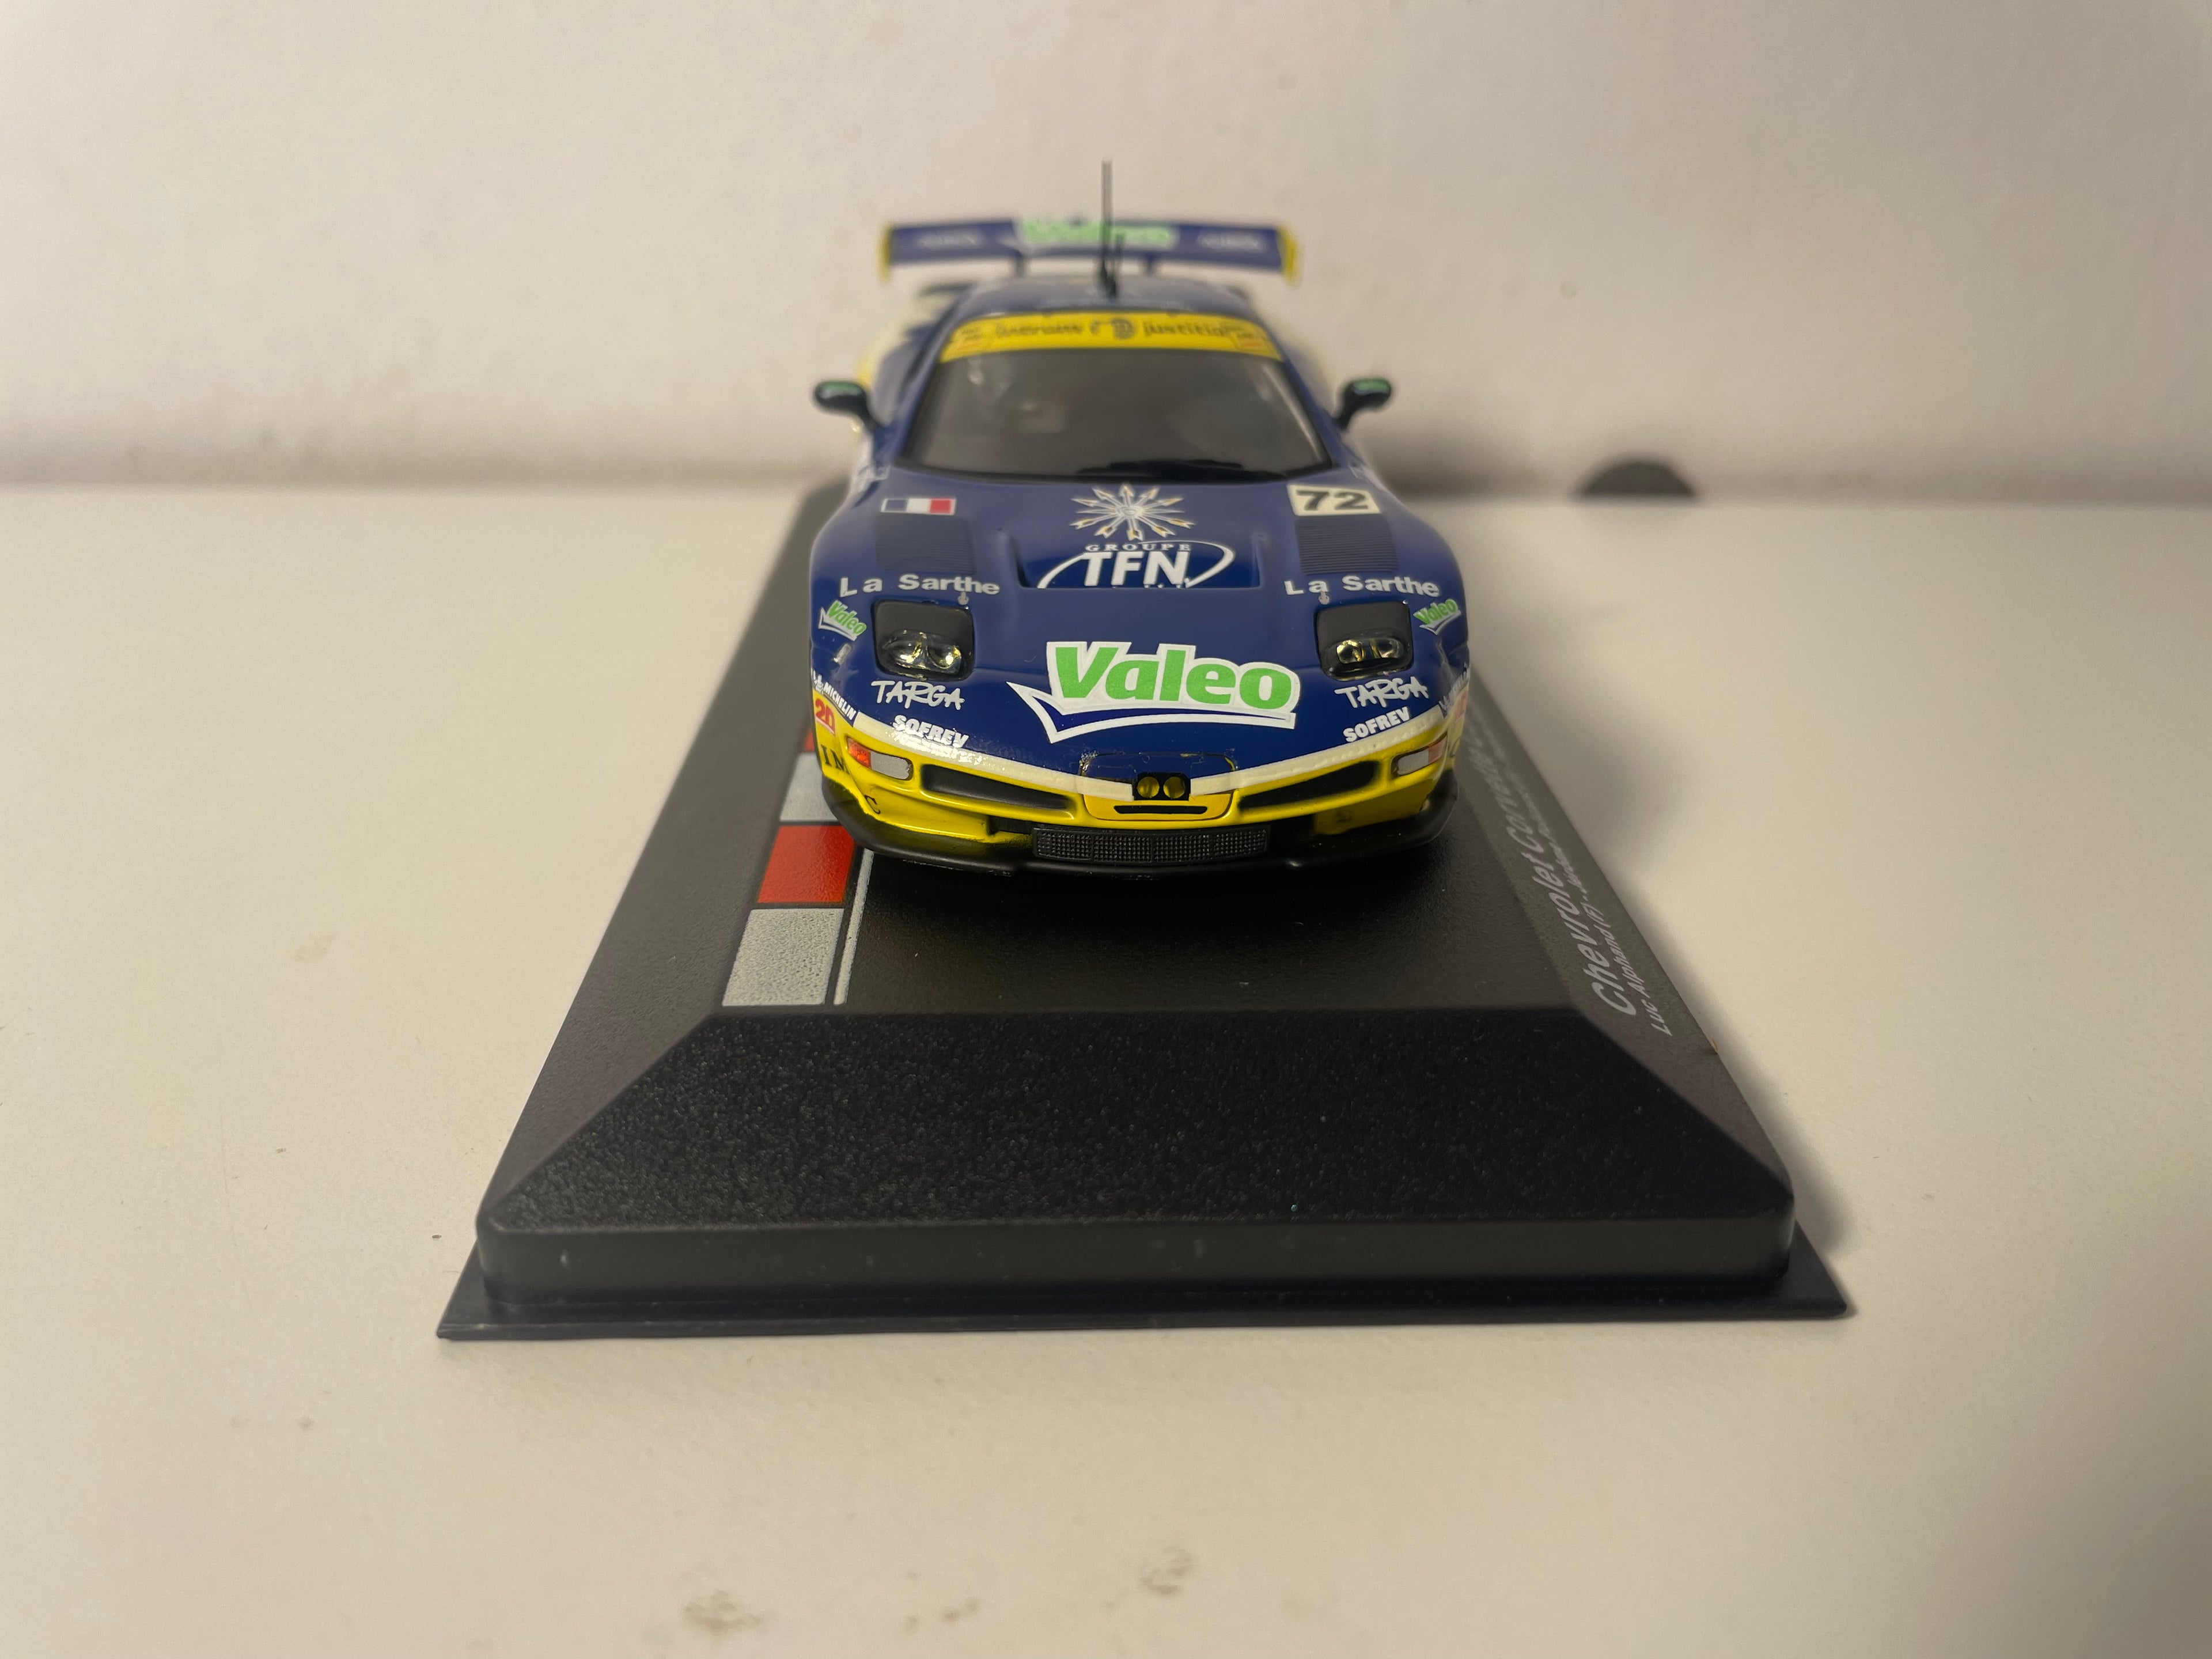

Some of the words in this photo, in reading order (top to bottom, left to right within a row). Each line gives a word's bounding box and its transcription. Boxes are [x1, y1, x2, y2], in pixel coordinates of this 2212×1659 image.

[1296, 490, 1369, 512] 72
[1085, 543, 1192, 552] GROUPE
[840, 577, 883, 597] La
[898, 574, 1000, 596] Sarthe
[1082, 551, 1190, 587] TFN
[1285, 578, 1329, 596] La
[1343, 575, 1440, 597] Sarthe
[828, 601, 866, 635] Valeo
[1414, 599, 1458, 624] Valeo
[870, 680, 965, 710] TARGA
[1053, 645, 1294, 711] Valeo
[1334, 676, 1429, 709] TARGA
[823, 682, 857, 720] MICHELIN
[893, 714, 969, 748] SOFREV
[1343, 706, 1410, 743] SOFREV
[1580, 902, 1611, 929] (F)
[1521, 851, 1637, 1016] Chevrolet
[1593, 923, 1651, 998] Alphand
[1641, 999, 1672, 1036] Luc
